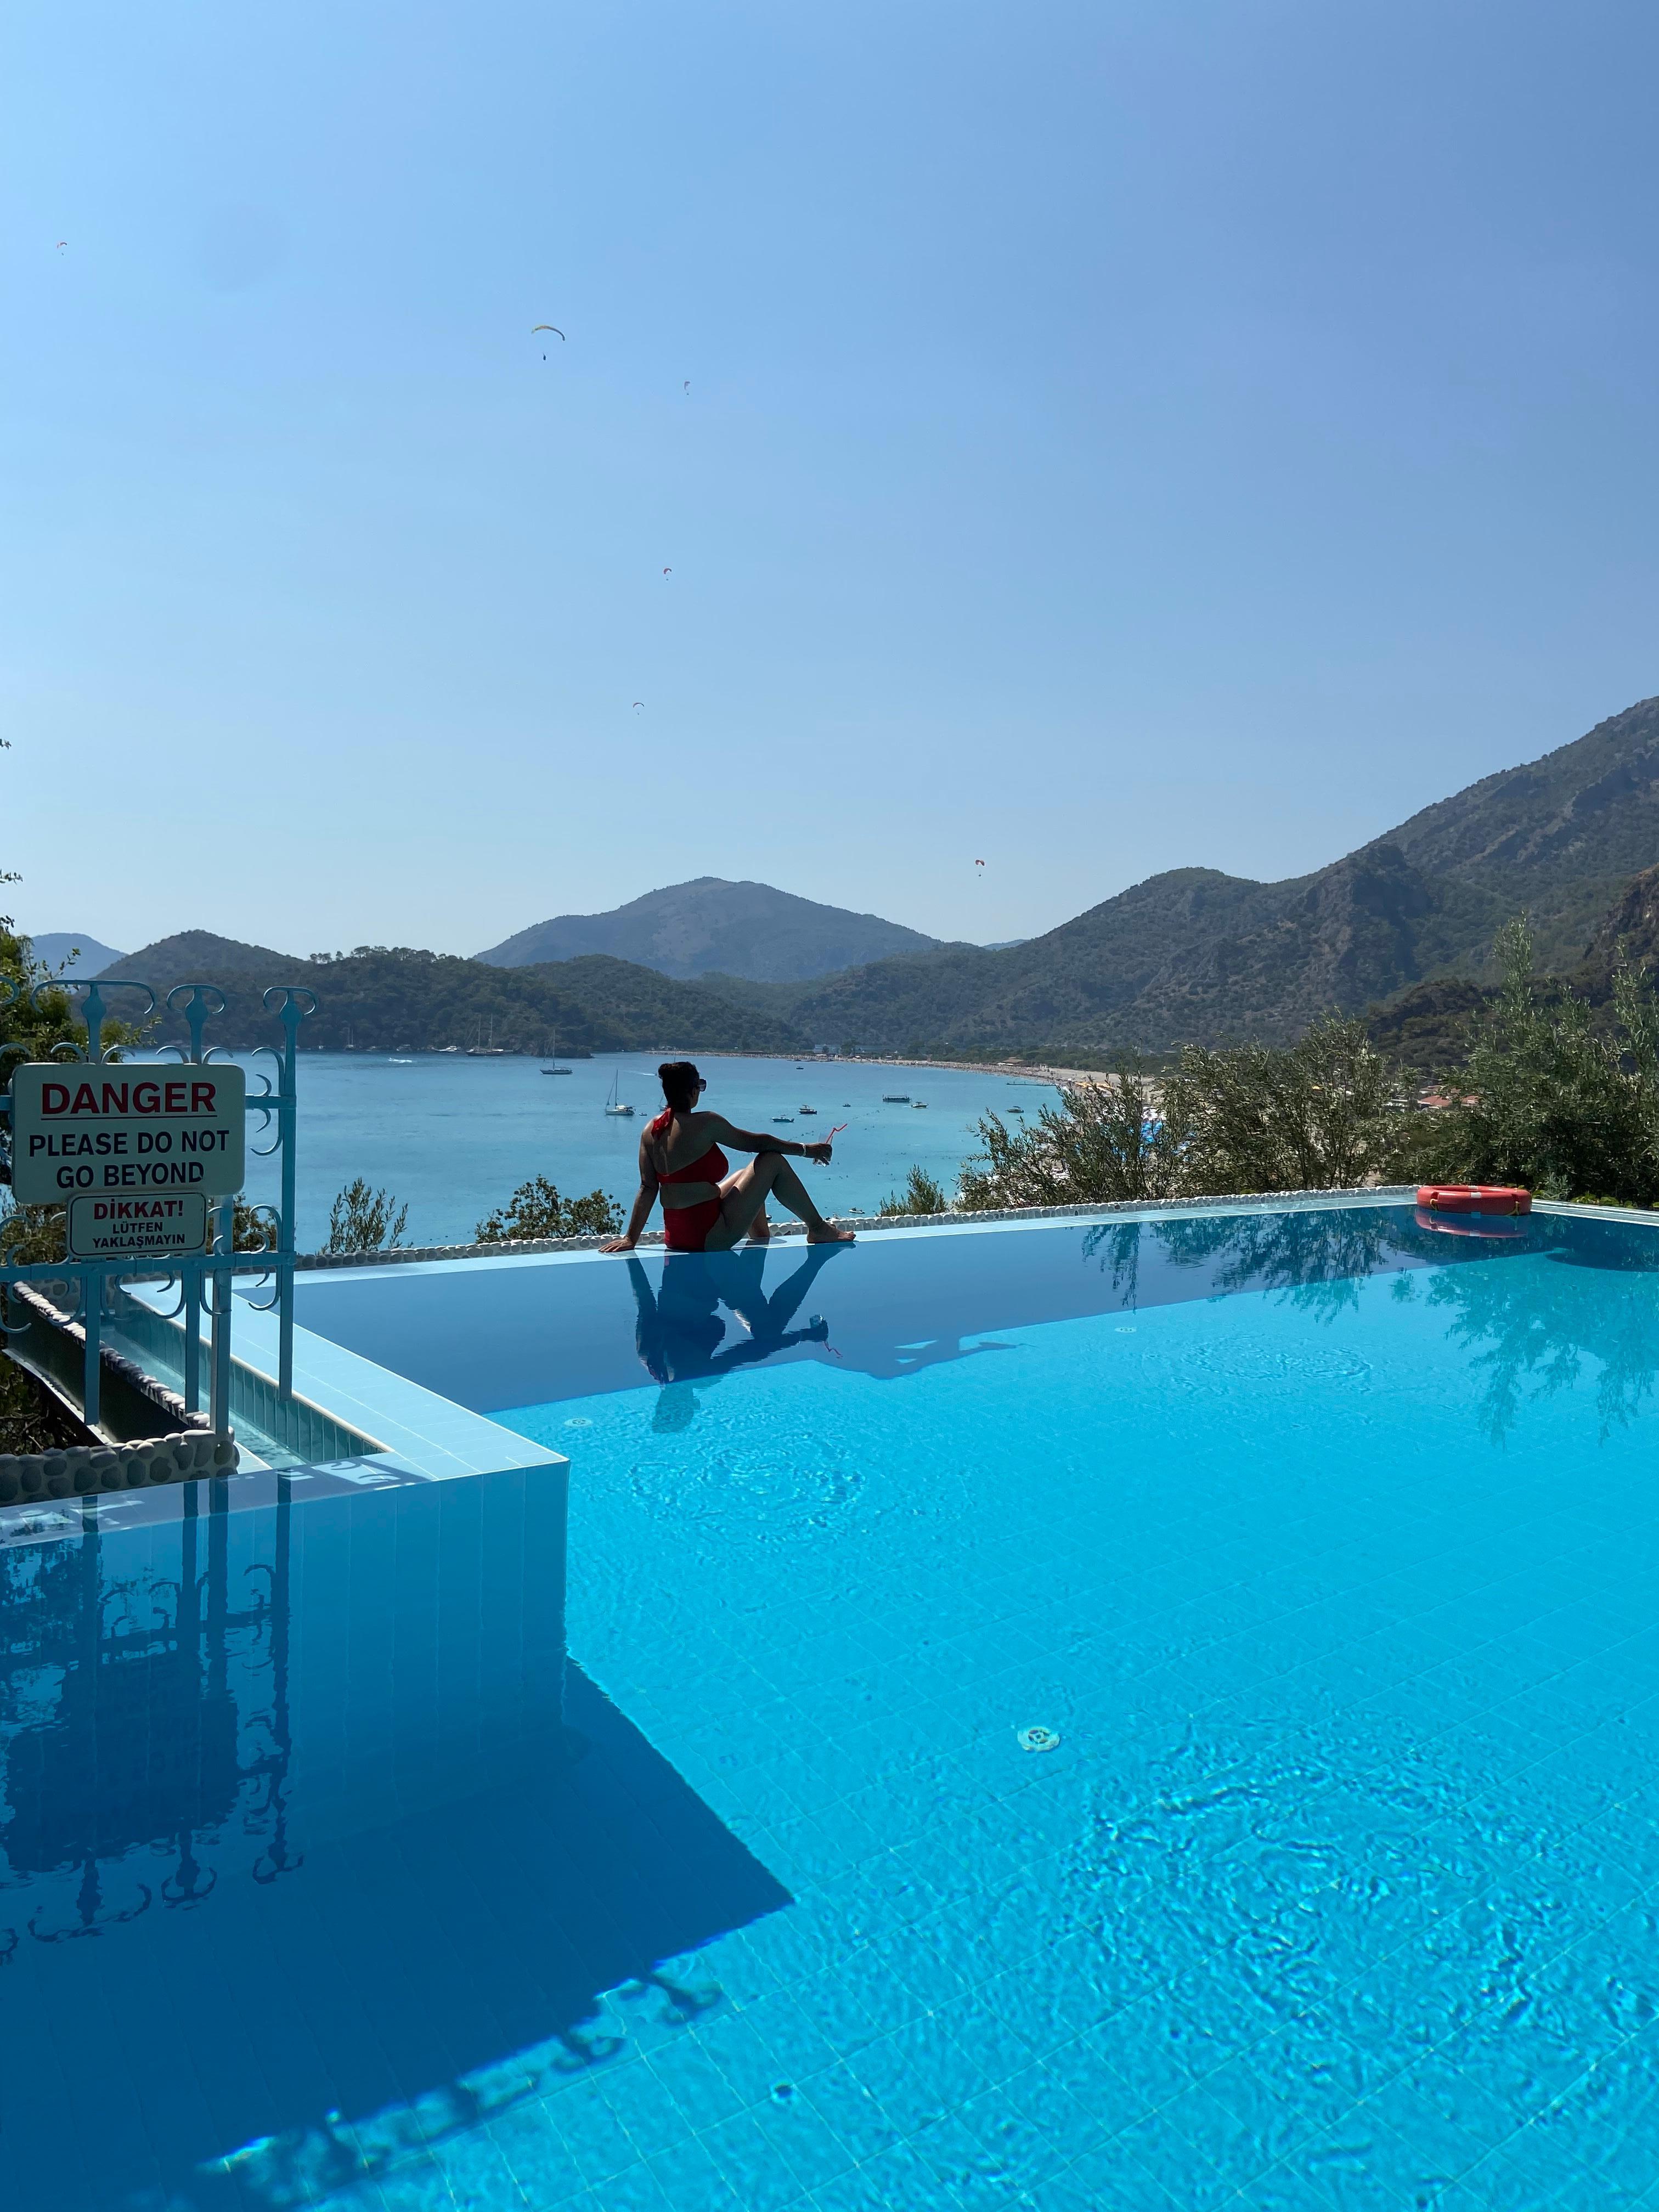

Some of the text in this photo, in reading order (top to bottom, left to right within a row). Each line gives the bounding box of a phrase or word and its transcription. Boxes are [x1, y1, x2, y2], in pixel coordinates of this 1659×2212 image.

[41, 1082, 216, 1114] DANGER
[29, 1130, 230, 1156] PLEASE DO NOT
[57, 1161, 204, 1189] GO BEYOND
[94, 1198, 183, 1220] DİKKAT!
[112, 1220, 163, 1234] LÜTFEN
[93, 1233, 185, 1249] YAKLAŞMAYIN
